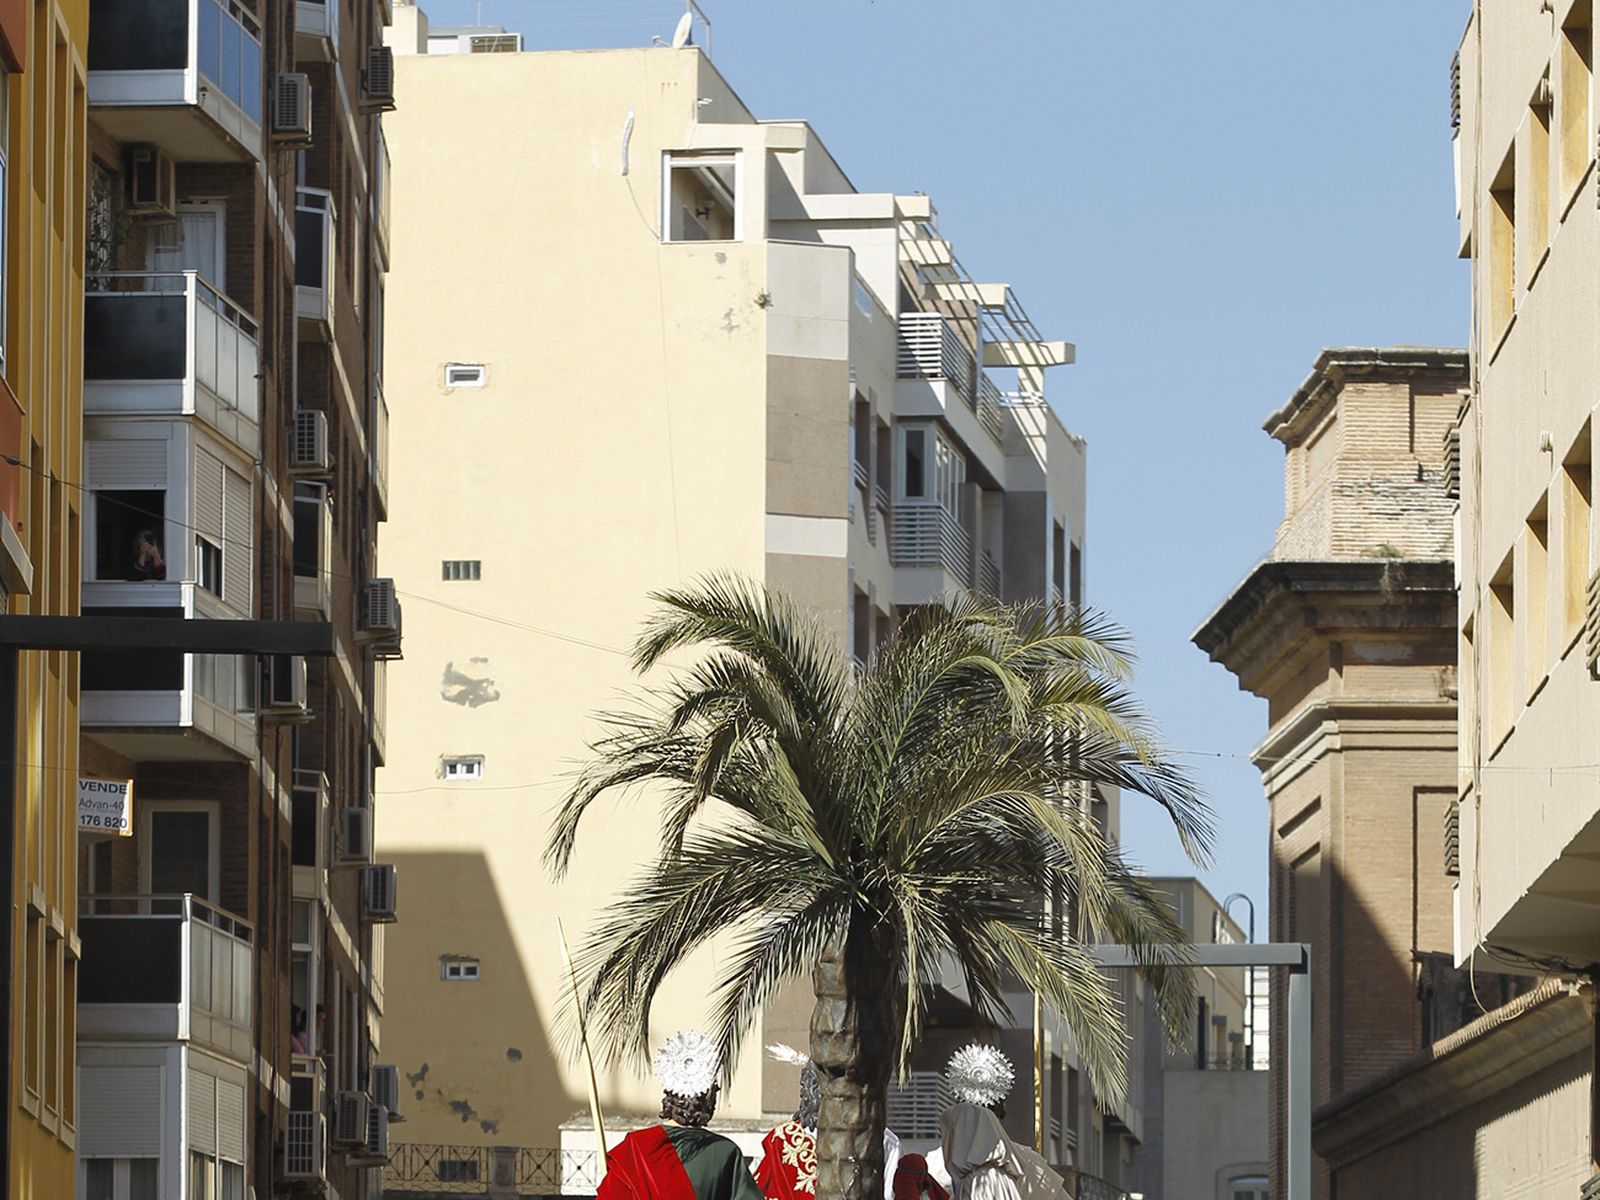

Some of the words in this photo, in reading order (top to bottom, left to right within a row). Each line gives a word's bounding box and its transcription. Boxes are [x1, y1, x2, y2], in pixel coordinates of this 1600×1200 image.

[79, 781, 127, 795] VENDE
[80, 815, 101, 826] 176
[104, 816, 127, 829] 820
